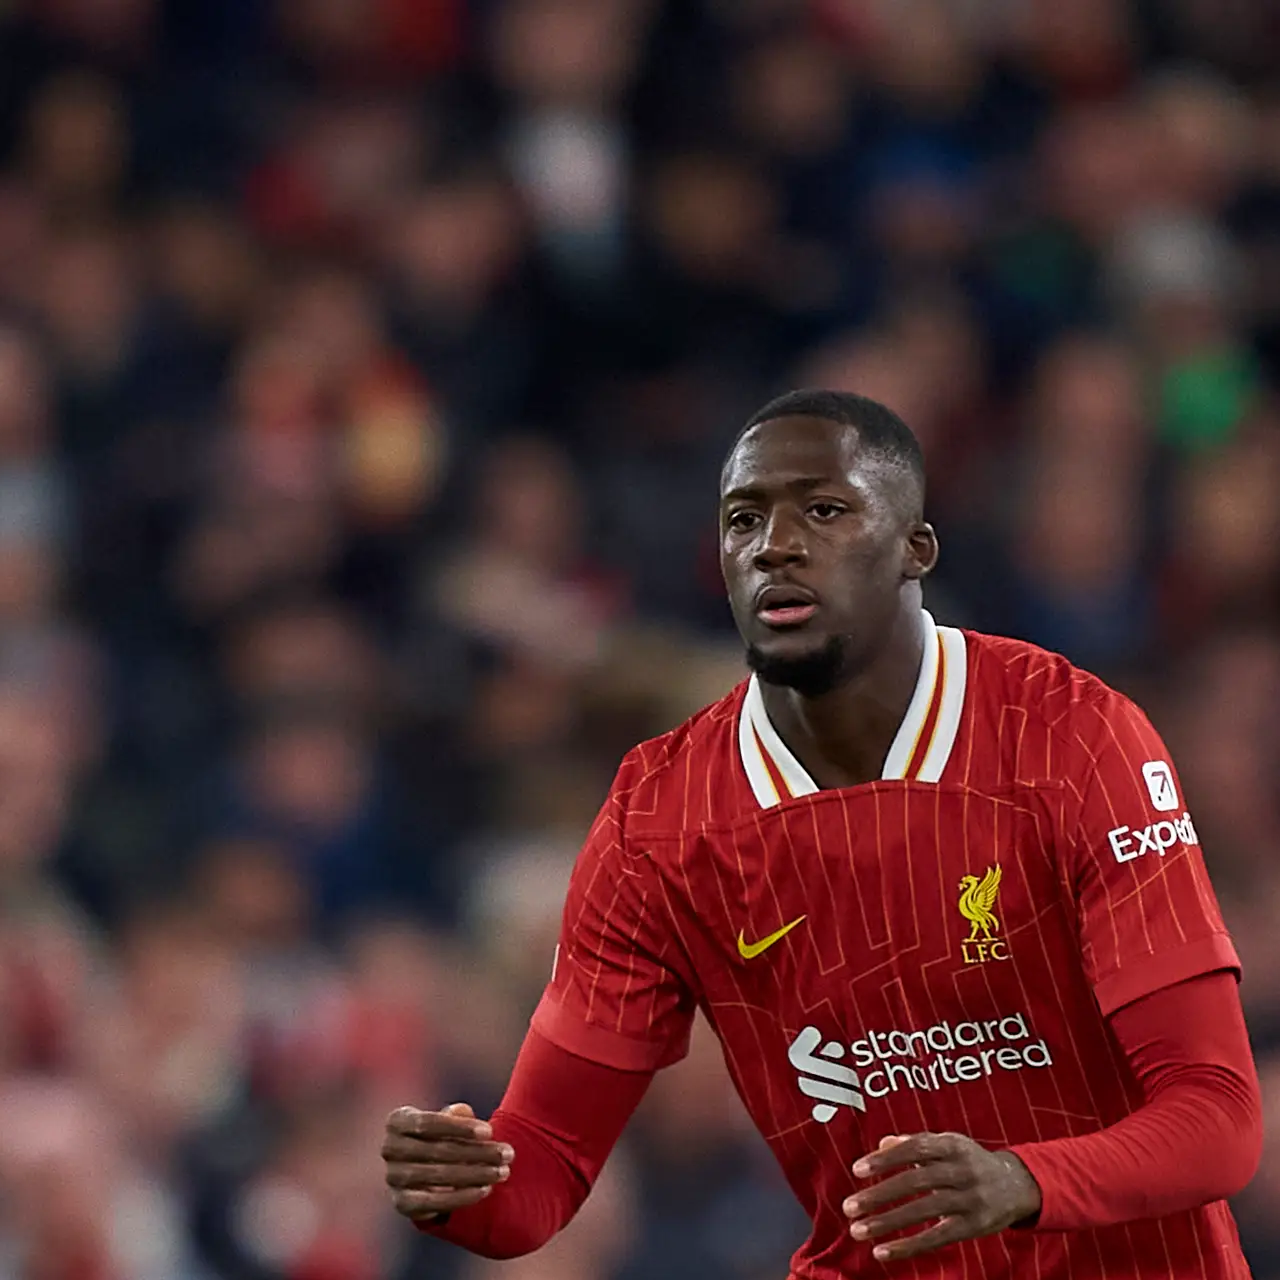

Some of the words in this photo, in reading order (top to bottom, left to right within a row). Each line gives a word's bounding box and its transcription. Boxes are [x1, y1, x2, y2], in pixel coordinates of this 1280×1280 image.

[1107, 812, 1198, 863] Expedi
[850, 1012, 1030, 1067] standard
[863, 1039, 1053, 1098] chartered
